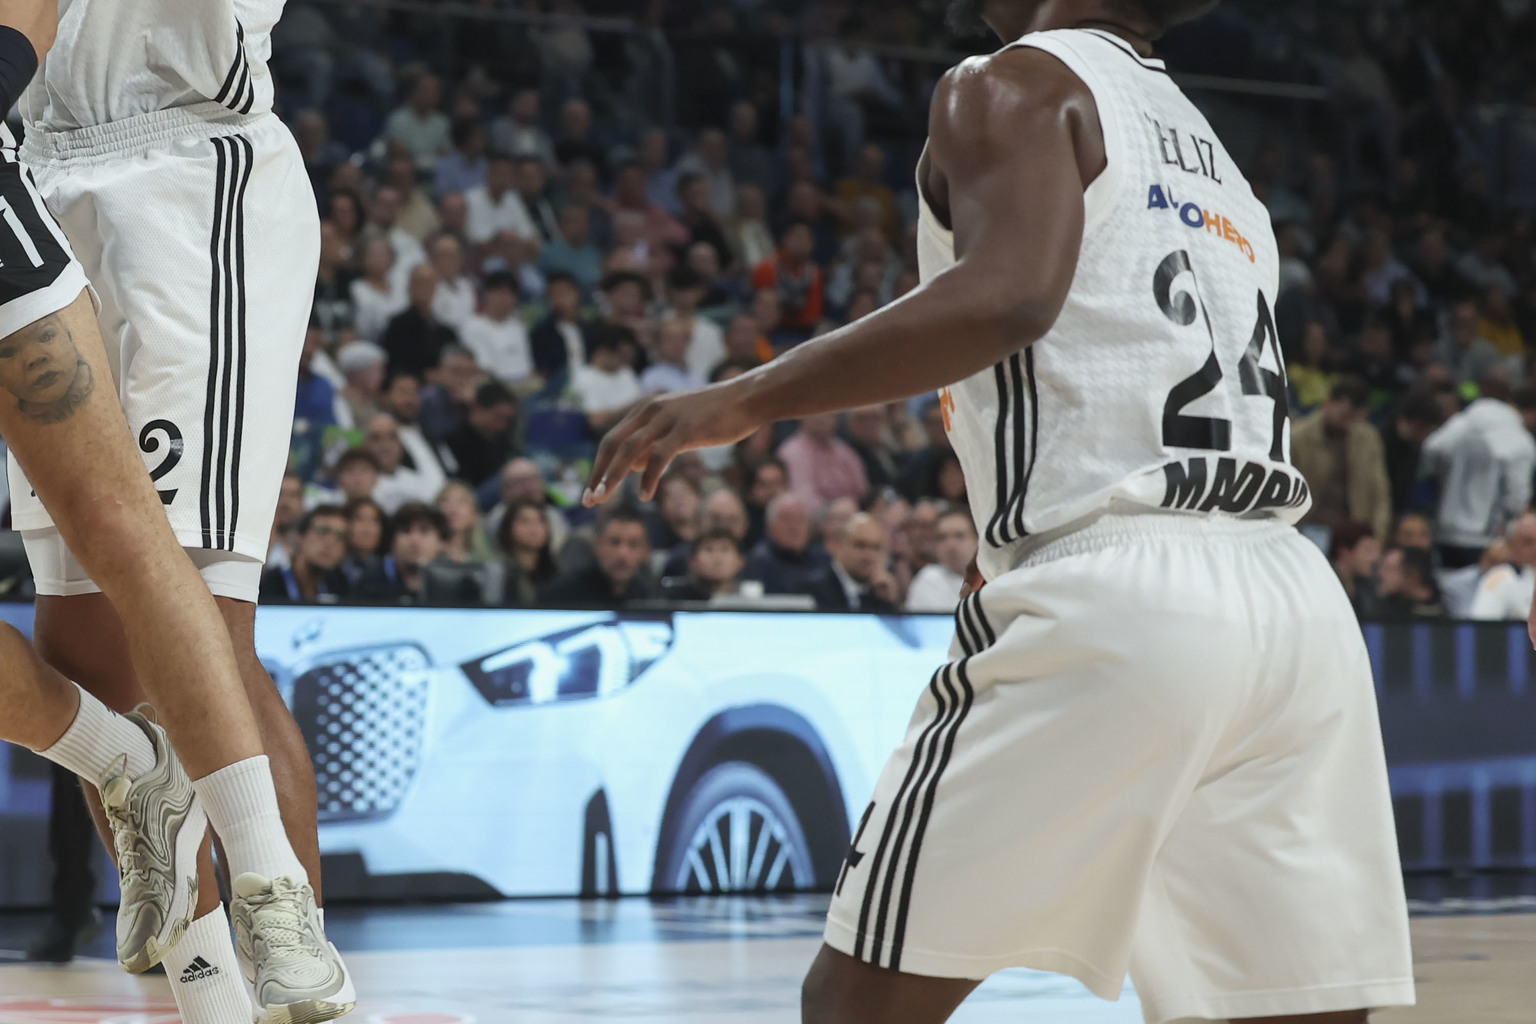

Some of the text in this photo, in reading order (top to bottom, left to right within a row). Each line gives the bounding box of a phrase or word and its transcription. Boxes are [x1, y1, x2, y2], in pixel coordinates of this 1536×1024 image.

[1144, 111, 1223, 186] ELIZ
[1152, 249, 1290, 463] 24
[180, 966, 219, 983] adidas
